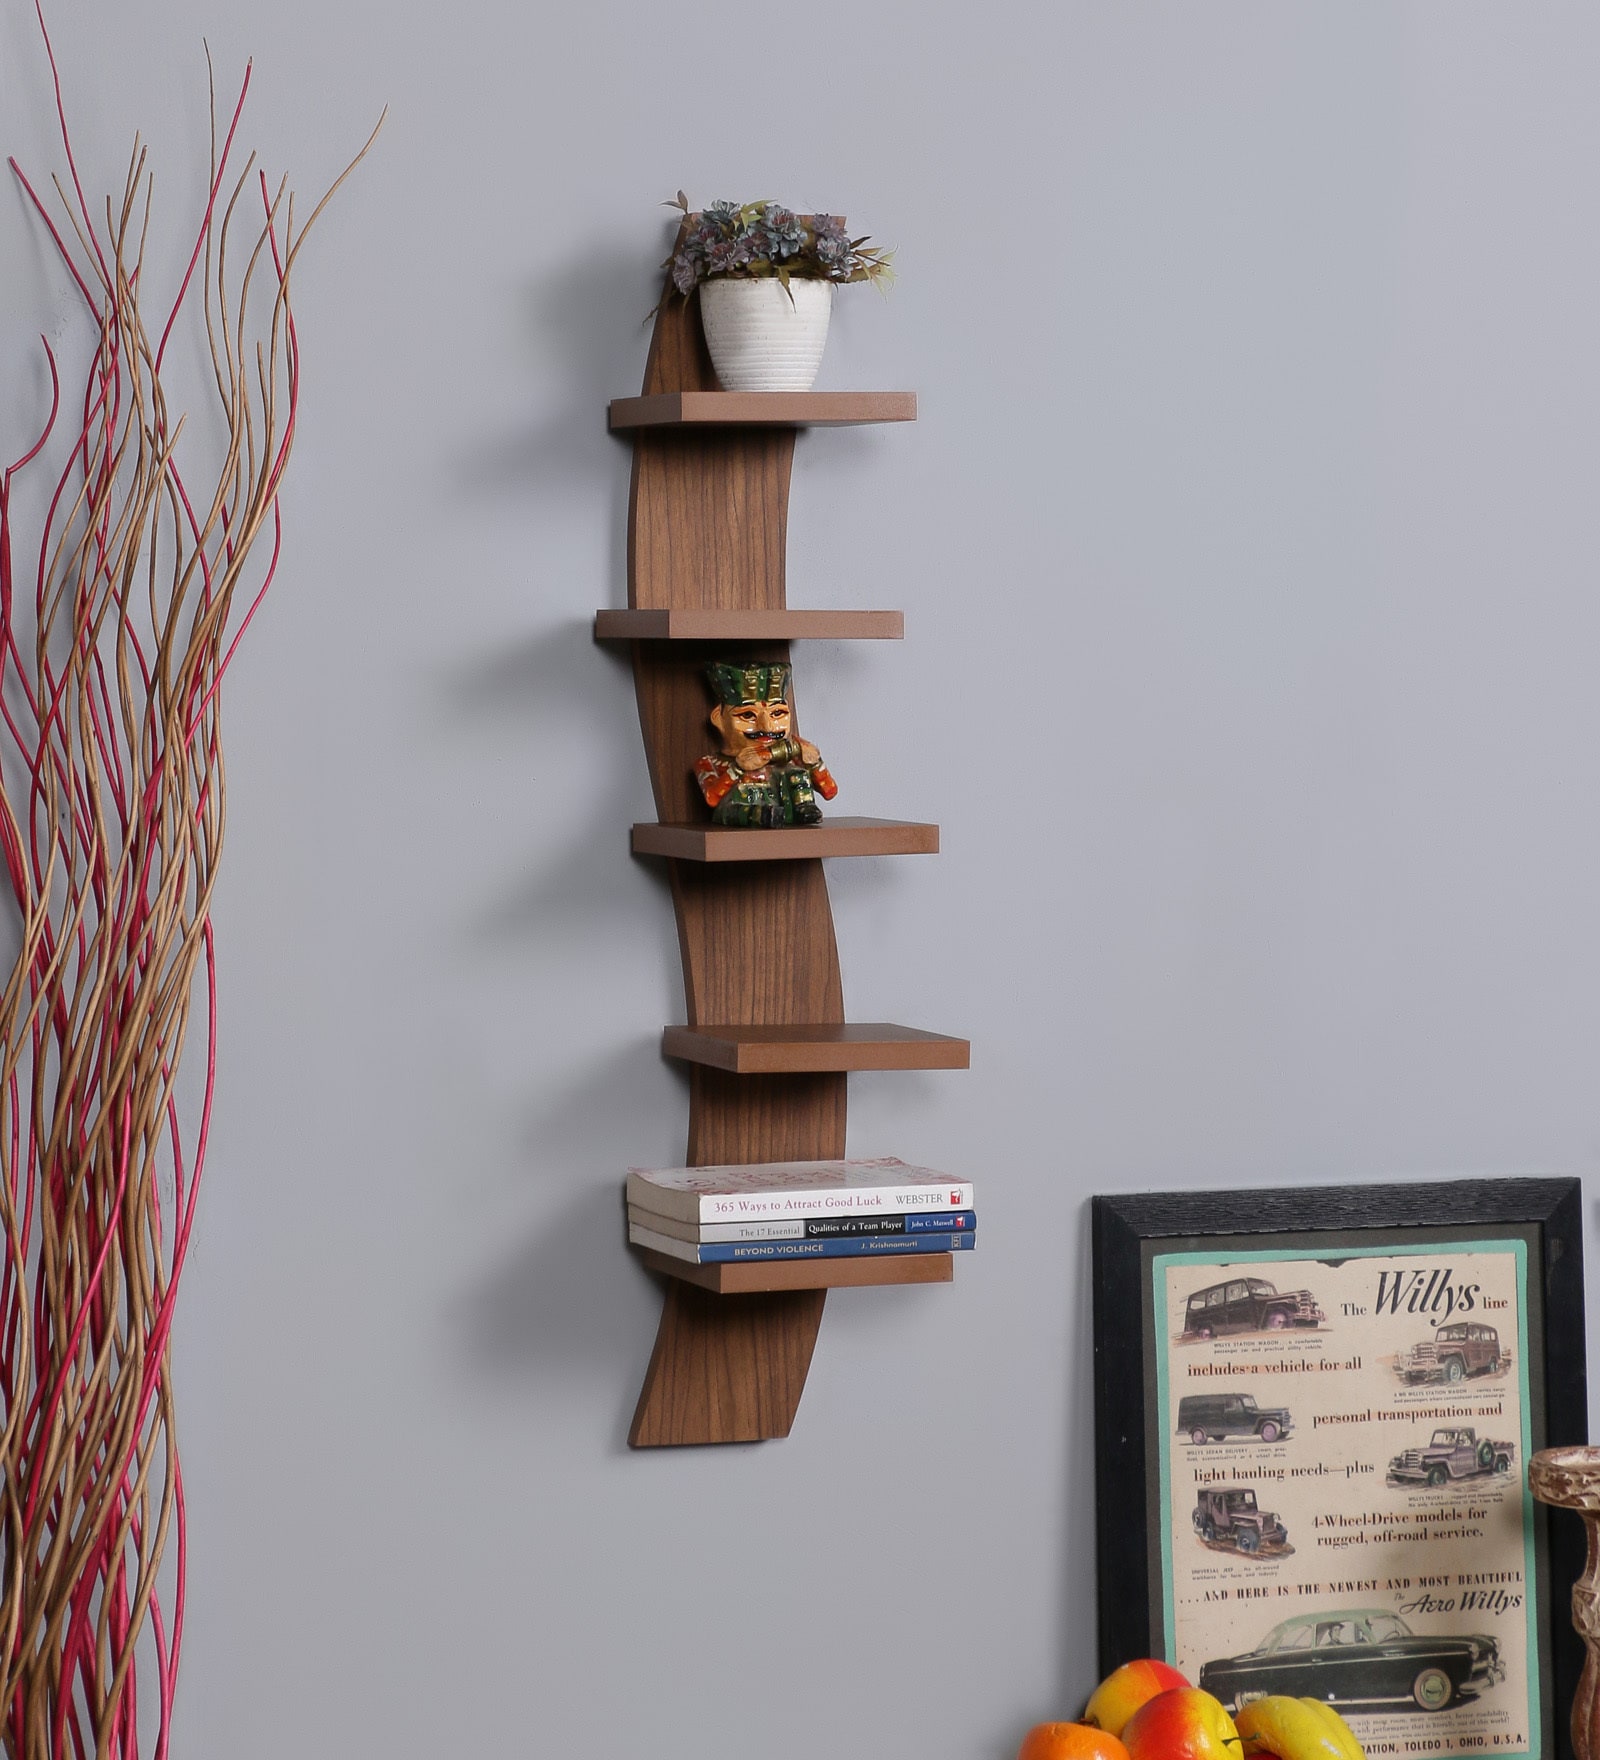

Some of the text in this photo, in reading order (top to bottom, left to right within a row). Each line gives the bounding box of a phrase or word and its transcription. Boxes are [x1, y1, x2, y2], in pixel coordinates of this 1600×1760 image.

[714, 1195, 882, 1215] 365 Ways to Attract Good Luck
[895, 1194, 943, 1205] WEBSTER
[740, 1229, 754, 1237] The
[767, 1226, 800, 1235] Essential
[808, 1223, 840, 1234] Qualities
[842, 1222, 851, 1231] of
[858, 1222, 879, 1230] Team
[881, 1221, 903, 1231] Player
[734, 1244, 824, 1256] BEYOND VIOLENCE
[1340, 1269, 1508, 1327] The Willys line
[1187, 1356, 1362, 1377] includes a vehicle for all
[1313, 1402, 1502, 1429] personal transportation and
[1193, 1467, 1226, 1485] light
[1232, 1465, 1285, 1483] hauling
[1311, 1507, 1488, 1529] 4-Wheel-Drive models for
[1317, 1525, 1484, 1550] rugged, off-road service.
[1237, 1587, 1269, 1600] HERE
[1277, 1585, 1289, 1597] IS
[1297, 1584, 1320, 1596] THE
[1329, 1580, 1377, 1593] NEWEST
[1386, 1578, 1410, 1590] AND
[1419, 1575, 1450, 1588] MOST
[1458, 1571, 1523, 1585] BEAUTIFUL
[1399, 1593, 1455, 1615] Aero
[1460, 1589, 1523, 1616] Willys
[1404, 1740, 1440, 1752] TOLEDO
[1446, 1739, 1453, 1750] 1,
[1460, 1736, 1487, 1748] OHIO,
[1493, 1734, 1526, 1746] U.S.A.
